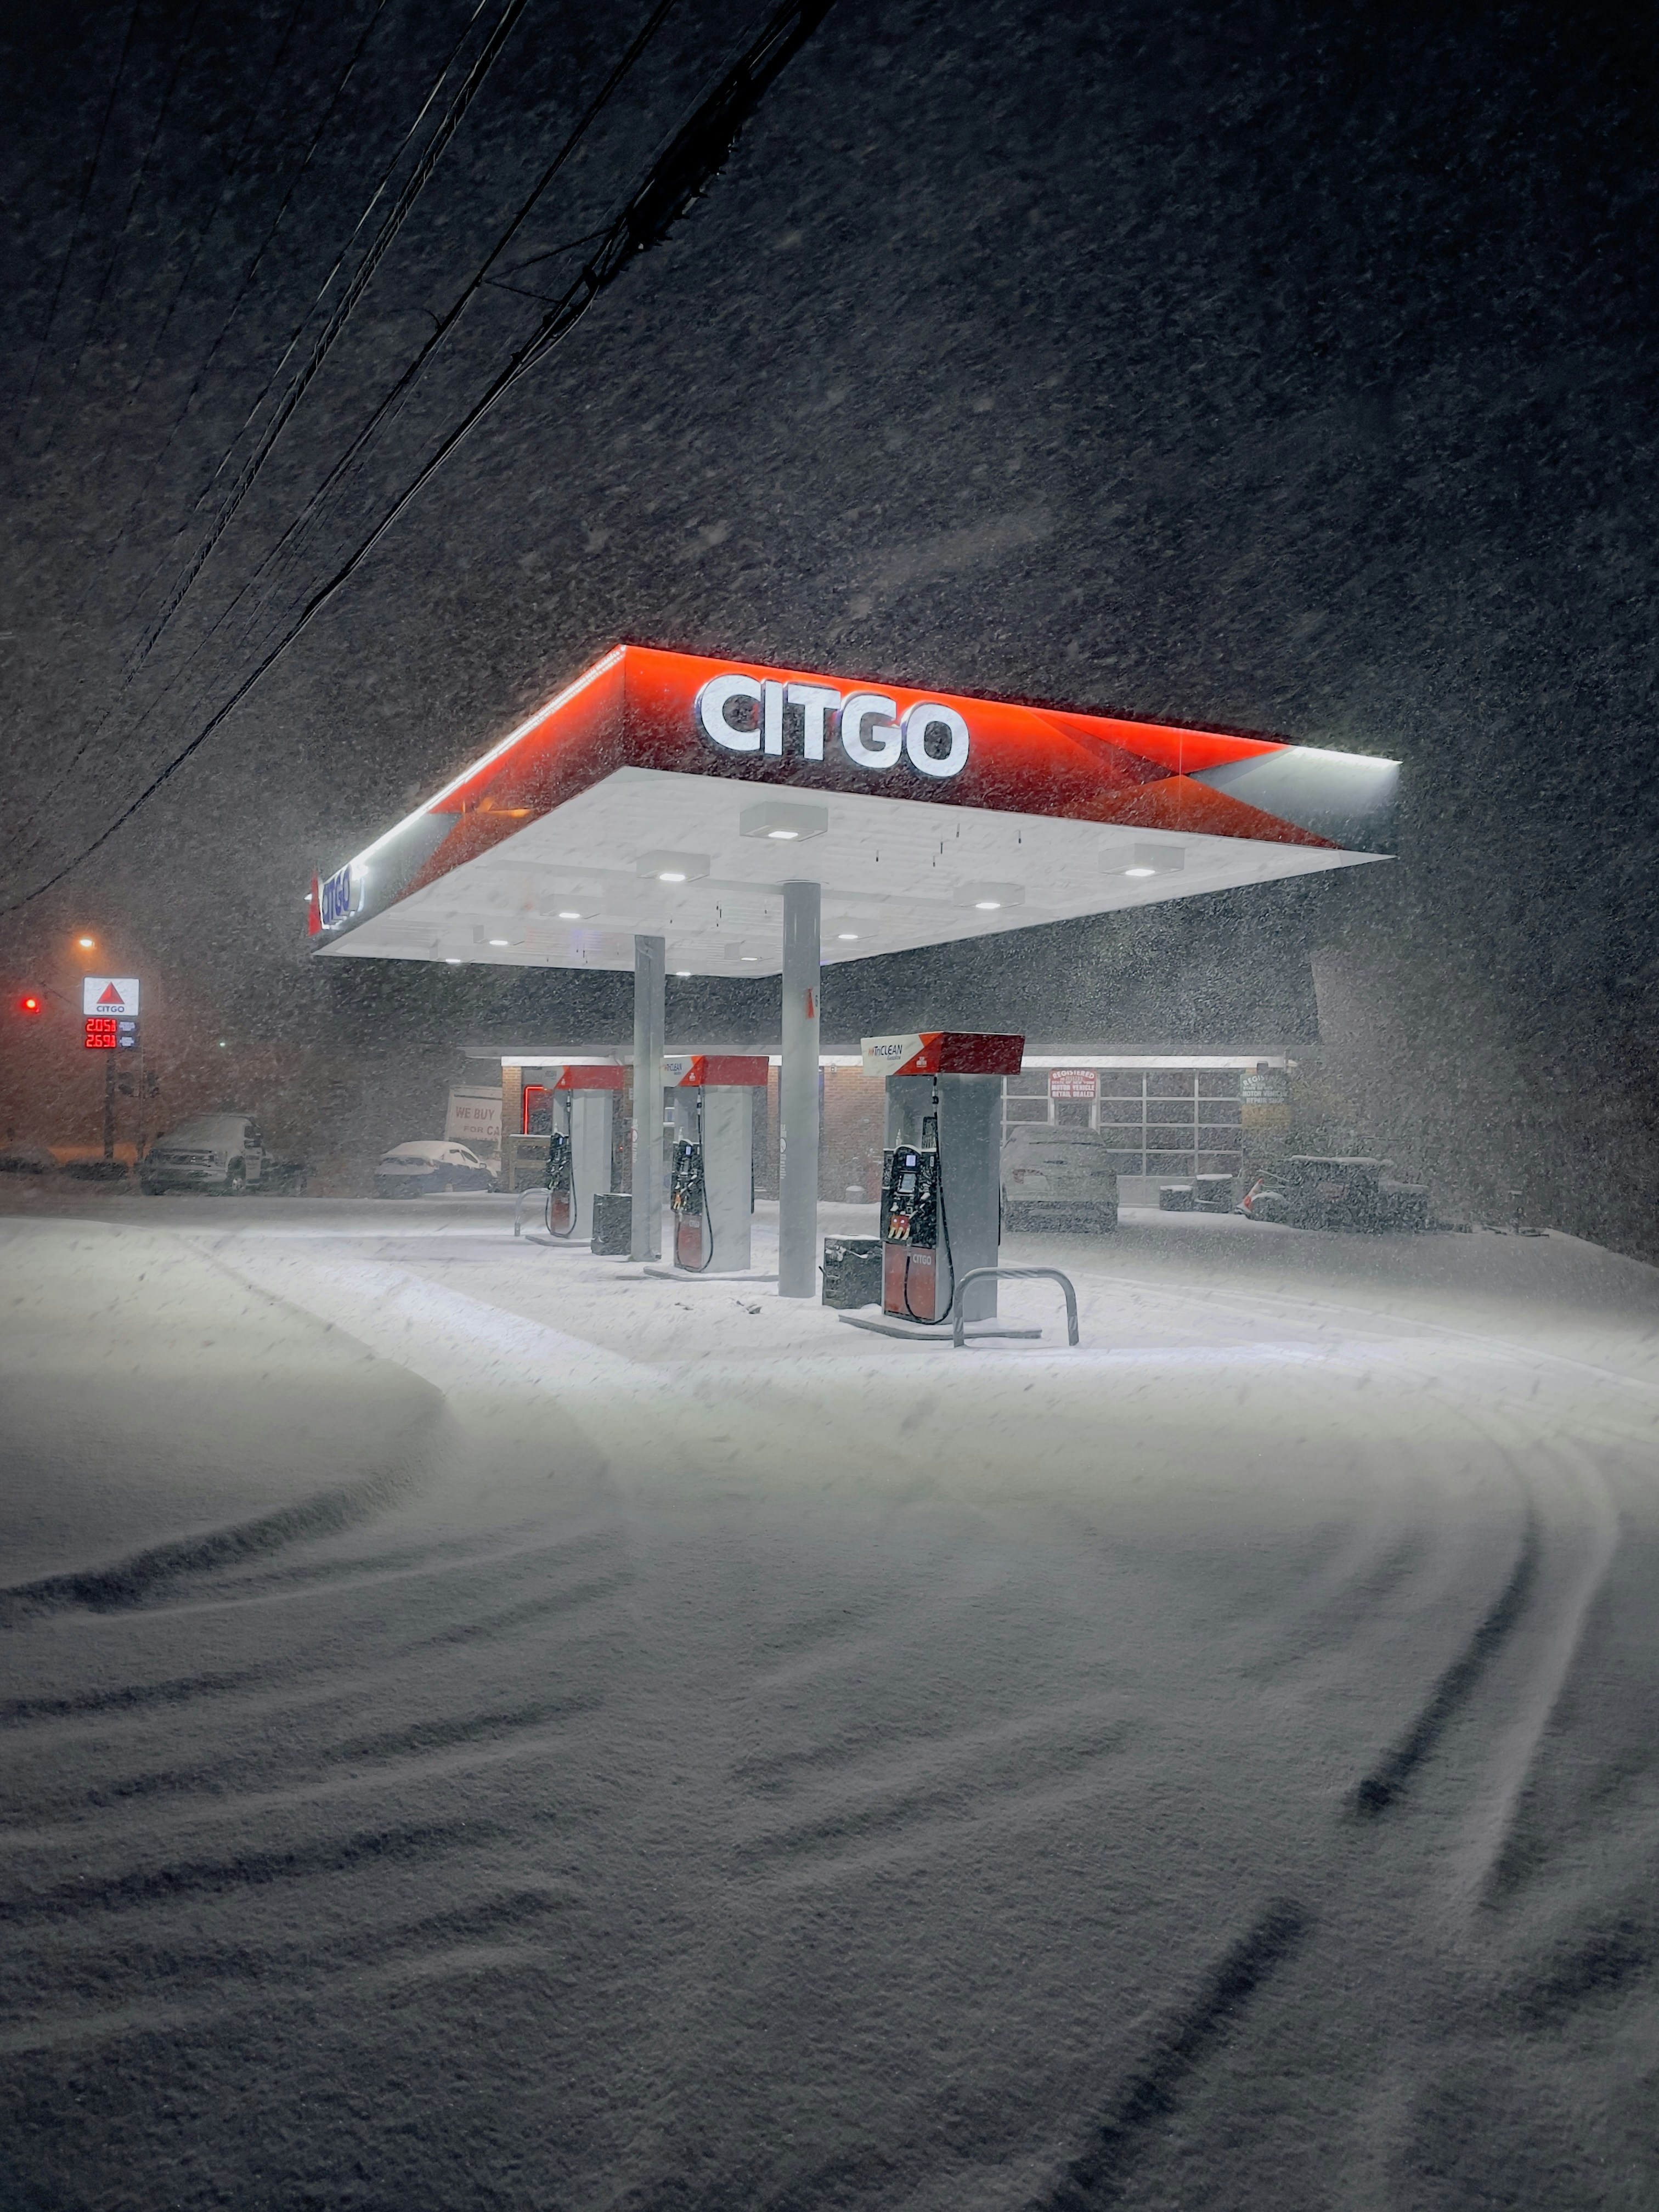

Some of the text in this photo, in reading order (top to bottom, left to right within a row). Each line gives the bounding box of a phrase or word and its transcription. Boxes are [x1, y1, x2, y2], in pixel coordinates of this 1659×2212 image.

[696, 674, 970, 778] CITGO
[1052, 1070, 1095, 1079] REGISTERED
[456, 1106, 495, 1120] WE BUY
[912, 1254, 932, 1265] CITGO
